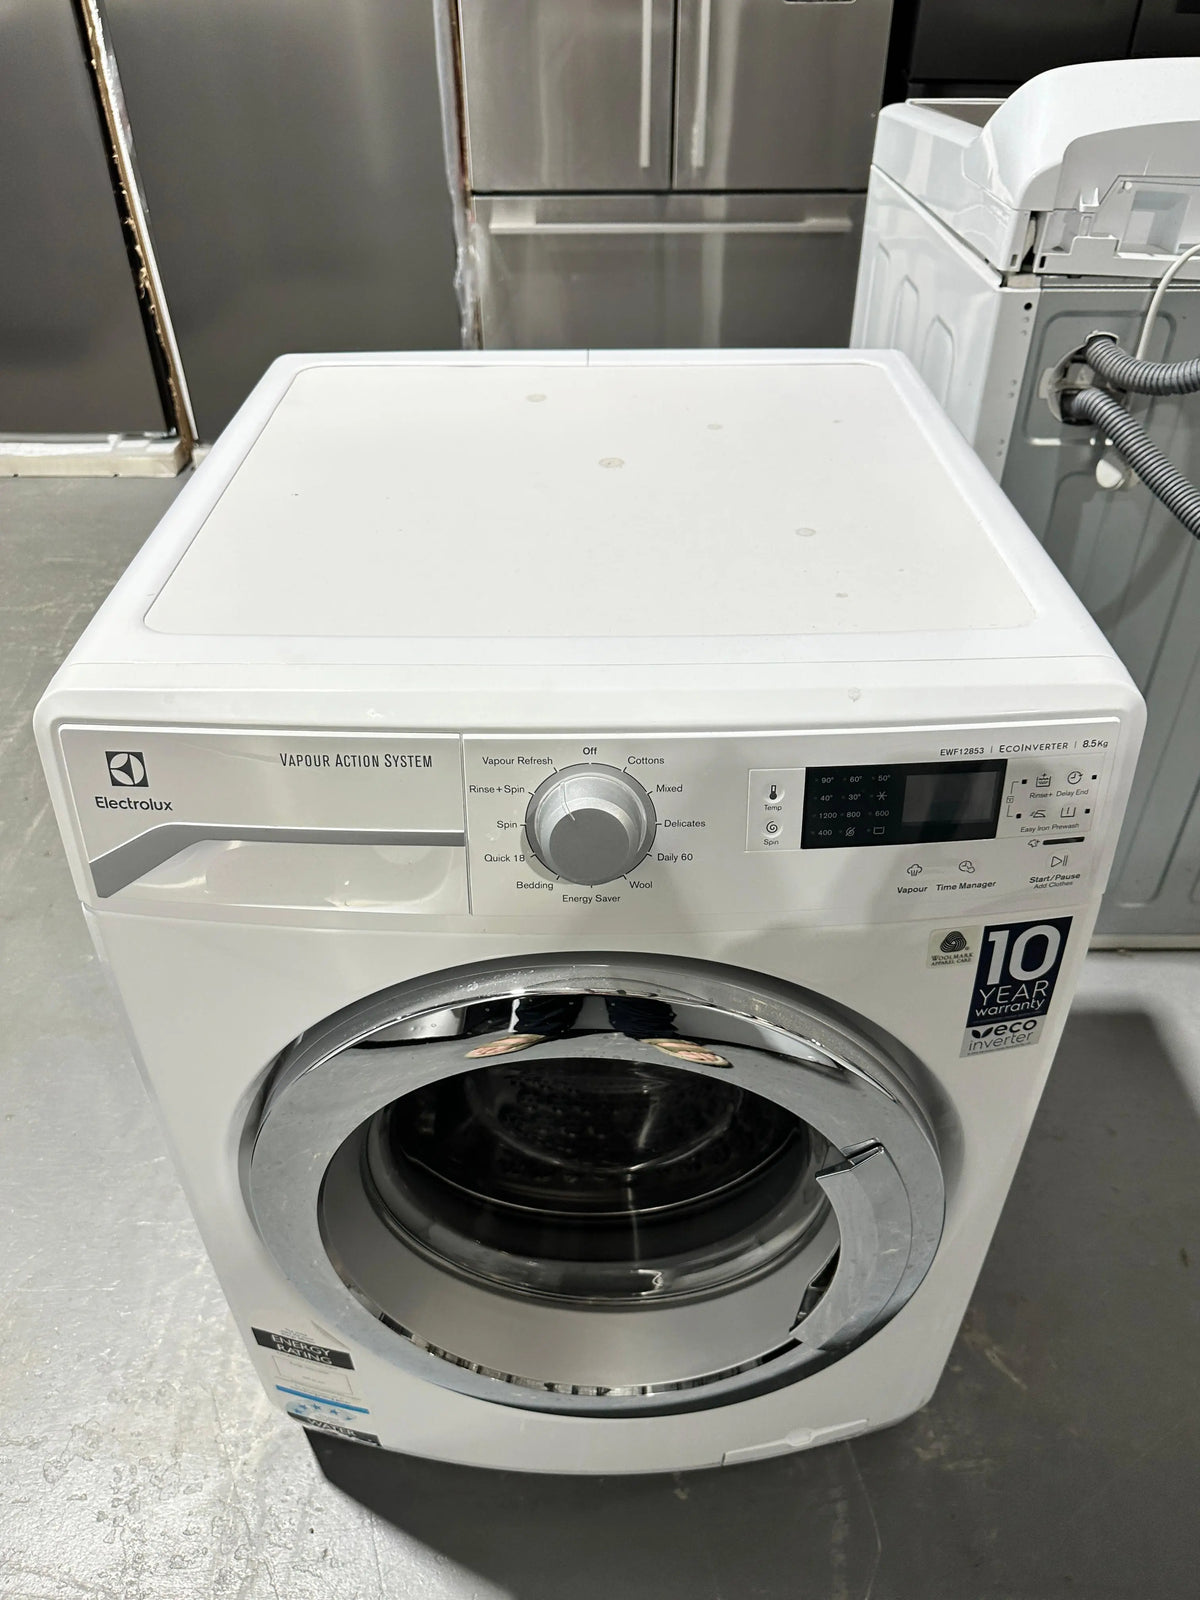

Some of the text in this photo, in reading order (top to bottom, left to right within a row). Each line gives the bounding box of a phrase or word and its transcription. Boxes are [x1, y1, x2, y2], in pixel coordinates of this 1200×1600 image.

[582, 747, 598, 756] Off
[940, 748, 984, 756] EWF12853
[482, 756, 553, 766] Vapour Refresh
[628, 756, 665, 764] Cottons
[656, 784, 683, 792] Mixed
[1056, 790, 1074, 798] Delay
[1076, 788, 1090, 796] End
[94, 796, 174, 812] Electrolux
[497, 820, 518, 830] Spin
[664, 819, 706, 828] Delicates
[1052, 822, 1080, 831] Prewash
[484, 854, 526, 862] Quick 18
[657, 853, 694, 862] Daily 60
[1028, 872, 1081, 884] Start/Pause
[516, 881, 554, 890] Bedding
[630, 880, 653, 889] Wool
[896, 880, 996, 894] Vapour Time Manager
[1048, 880, 1074, 888] Clothes
[562, 894, 620, 904] Energy Saver
[986, 924, 1061, 986] 10
[980, 980, 1049, 1006] YEAR
[975, 998, 1046, 1017] warranty
[994, 1019, 1038, 1036] eco
[968, 1032, 1034, 1052] inverter
[271, 1334, 330, 1356] ENERGY
[277, 1343, 333, 1365] RATING
